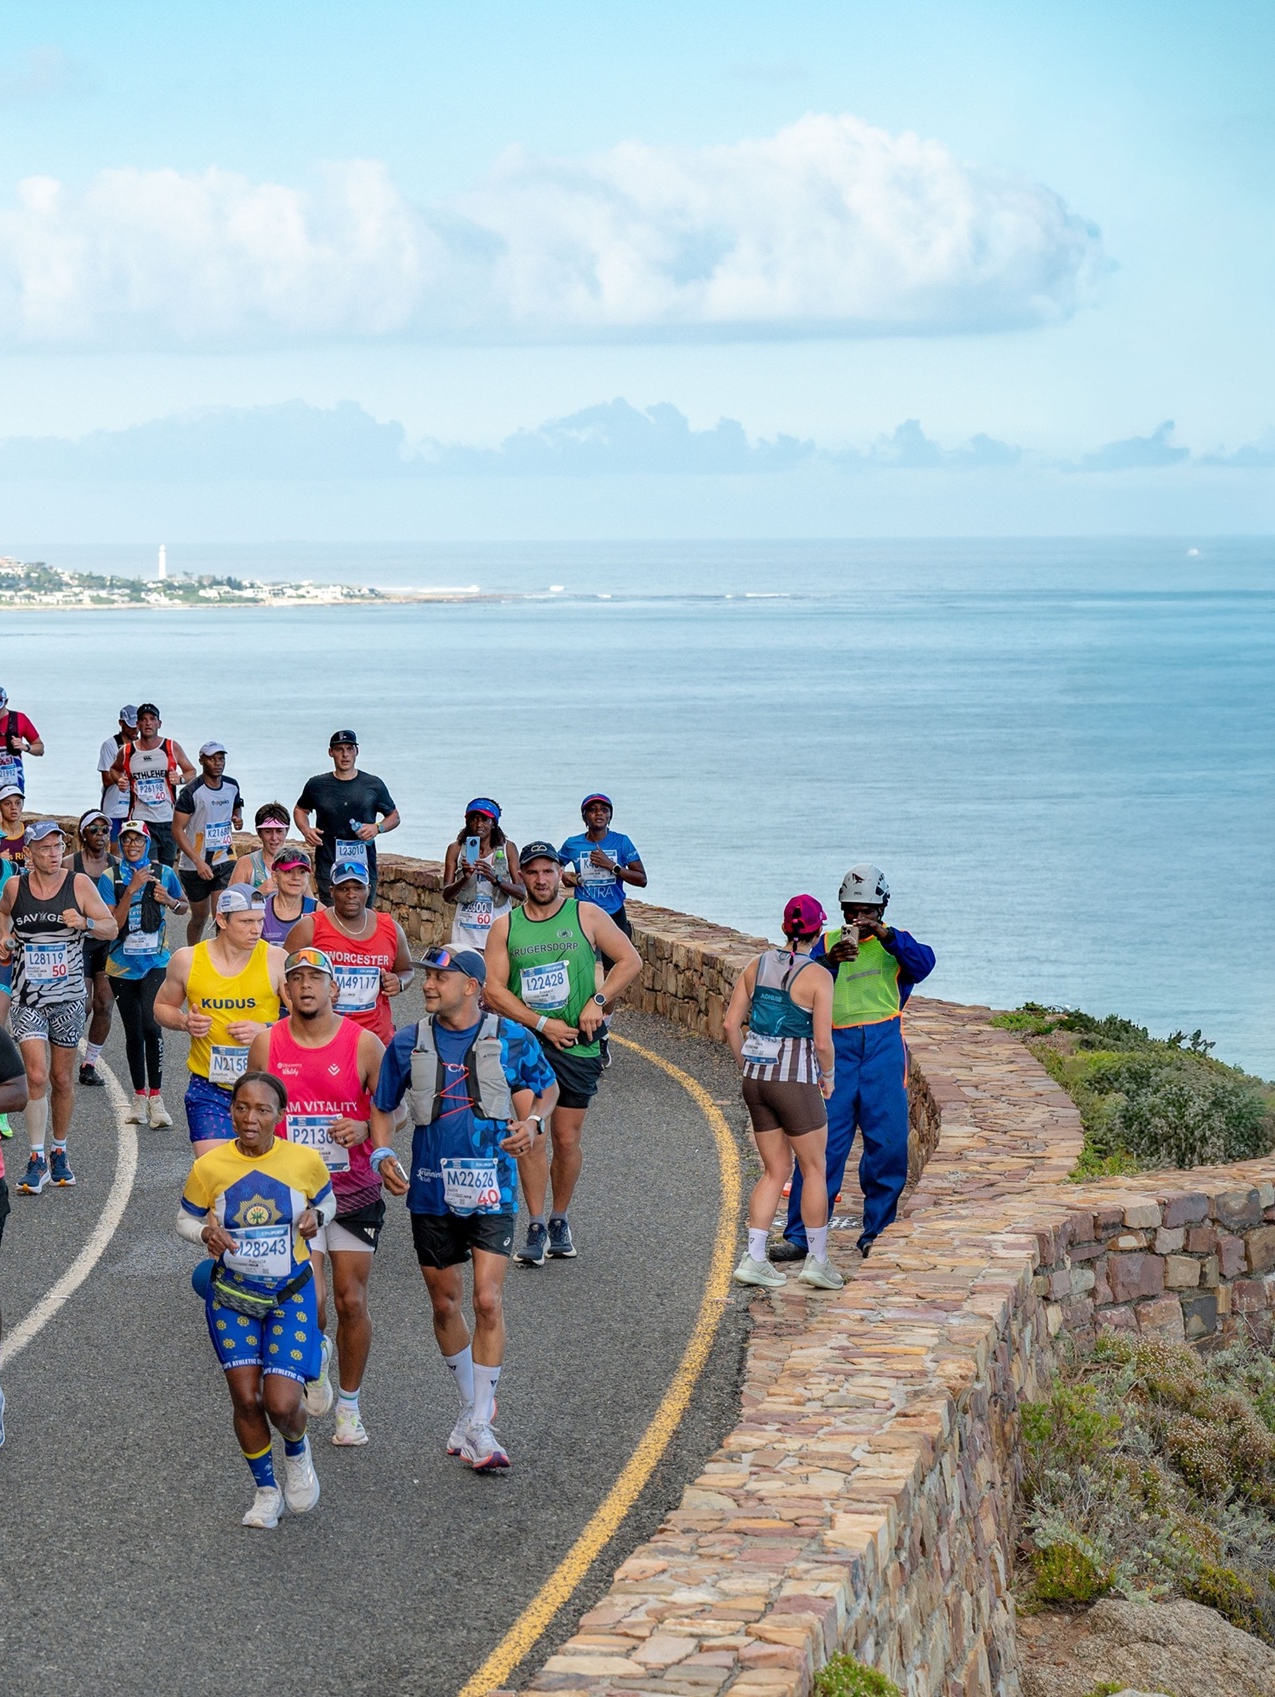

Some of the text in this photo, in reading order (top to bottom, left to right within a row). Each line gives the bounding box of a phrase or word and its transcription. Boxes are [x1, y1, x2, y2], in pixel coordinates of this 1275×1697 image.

[139, 784, 163, 793] P26198
[155, 792, 165, 800] 40
[16, 913, 64, 926] SAVGE
[477, 914, 490, 924] 60
[30, 953, 63, 965] L28119
[325, 951, 389, 966] WORCESTER
[52, 964, 66, 977] 50
[336, 976, 377, 989] M49117
[527, 972, 564, 991] L22428
[201, 997, 256, 1009] KUDUS
[213, 1056, 247, 1072] N2158
[304, 1100, 358, 1112] VITALITY
[447, 1171, 494, 1187] M22626
[477, 1189, 499, 1205] 40
[232, 1358, 256, 1367] ATHLETIC
[272, 1367, 296, 1379] ATHLETIC
